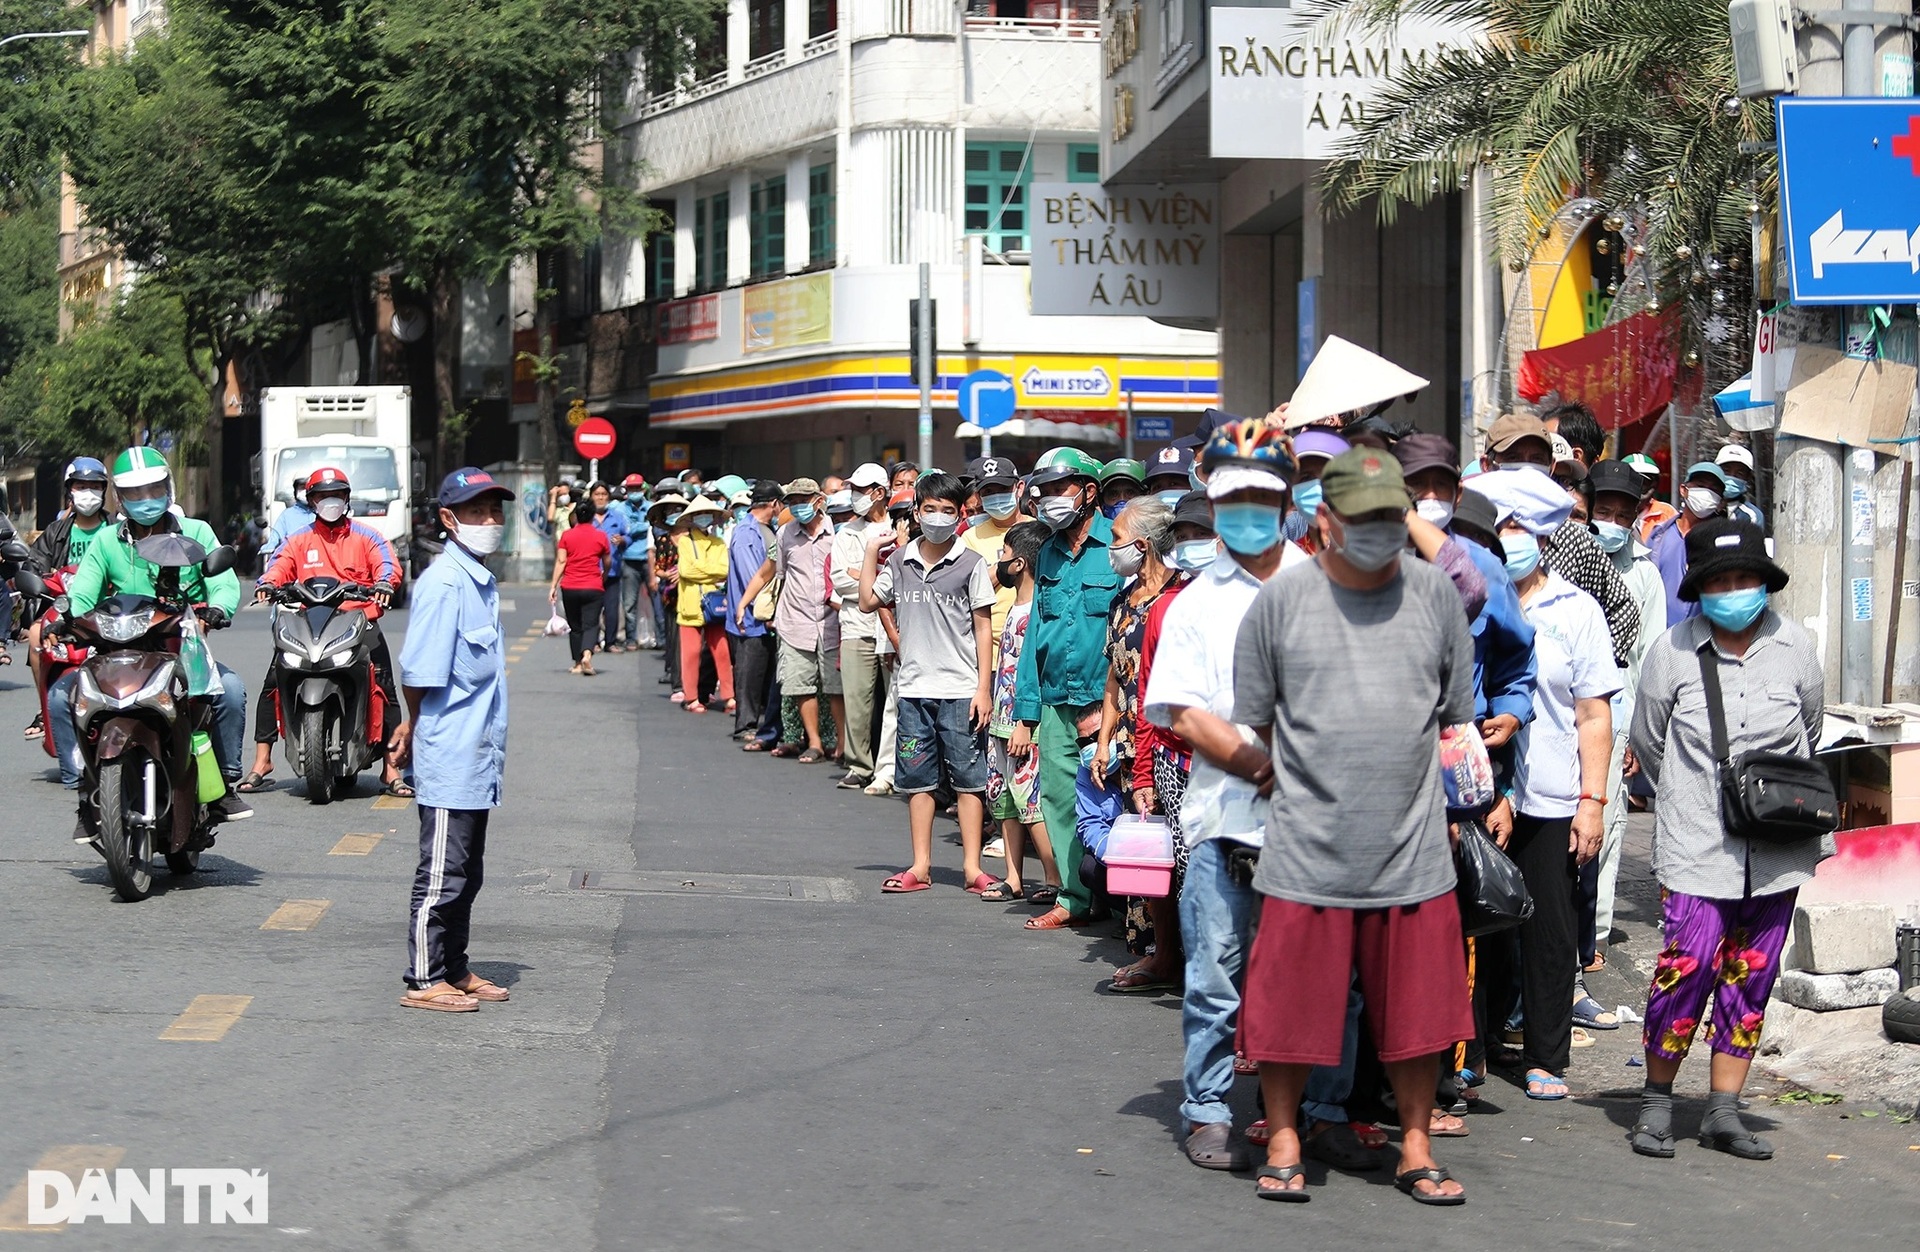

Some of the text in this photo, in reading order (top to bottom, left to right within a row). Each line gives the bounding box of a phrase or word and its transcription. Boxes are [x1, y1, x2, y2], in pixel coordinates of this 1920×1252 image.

[1218, 36, 1308, 78] RĂNG
[1313, 39, 1392, 78] HÀM
[1306, 91, 1329, 130] Á
[1043, 191, 1213, 231] BỆNH VIỆN
[1051, 225, 1206, 266] THẨM MỸ
[1089, 273, 1162, 306] Á ÂU
[1032, 378, 1102, 390] MINI STOP
